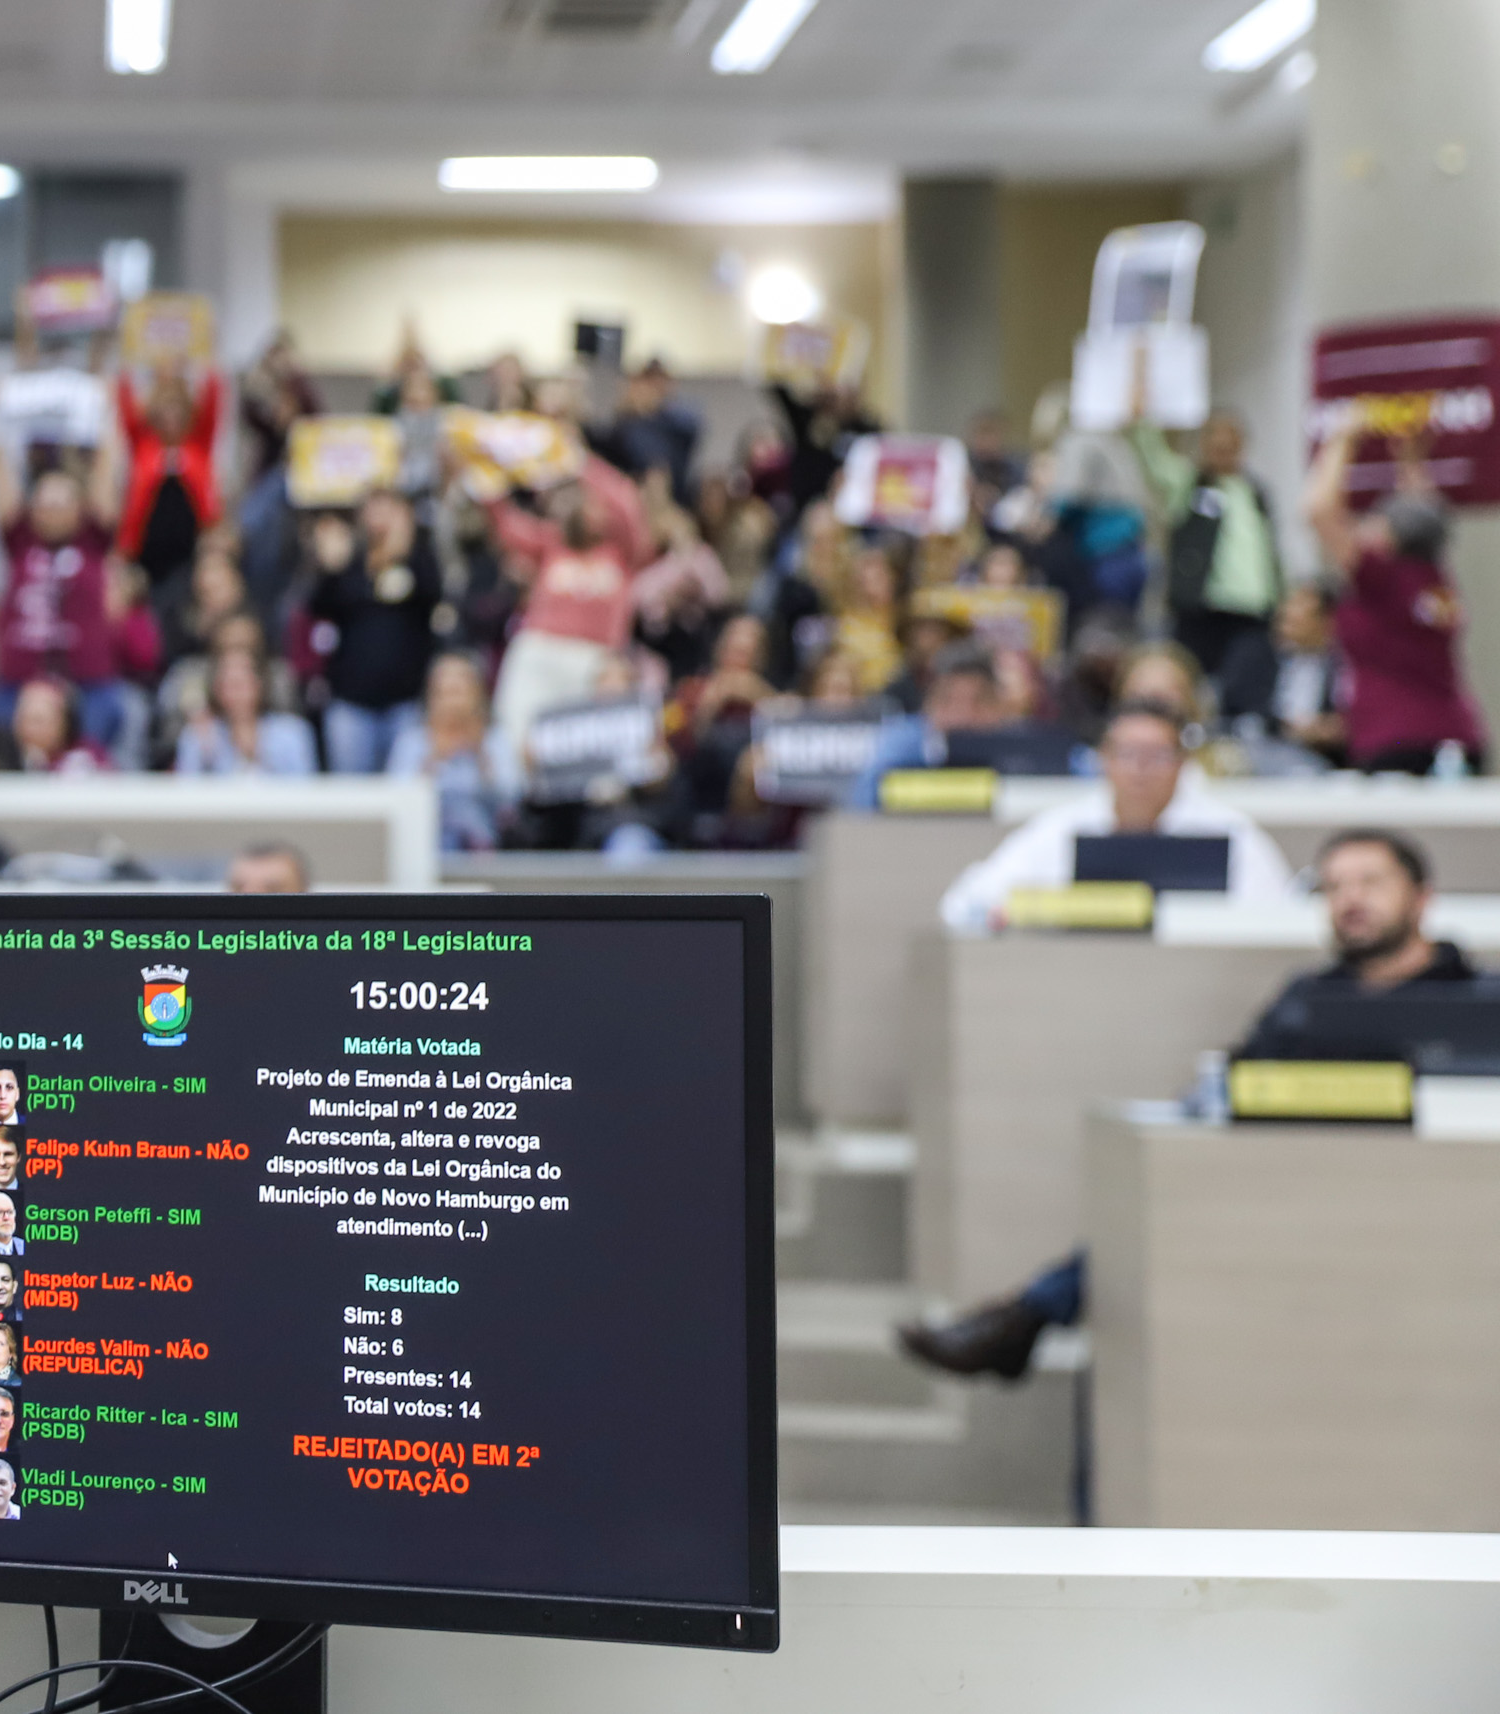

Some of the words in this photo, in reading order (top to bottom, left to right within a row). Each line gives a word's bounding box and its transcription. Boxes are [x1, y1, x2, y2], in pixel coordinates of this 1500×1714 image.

[50, 930, 76, 949] da
[110, 930, 190, 949] Sessão
[198, 930, 318, 954] Legislativa
[326, 930, 352, 950] da
[404, 931, 532, 955] Legislatura
[350, 981, 489, 1010] 15:00:24
[18, 1033, 46, 1050] Dia
[63, 1034, 83, 1050] 14
[344, 1037, 412, 1055] Matéria
[417, 1038, 481, 1056] Votada
[28, 1075, 83, 1091] Darlan
[89, 1076, 156, 1092] Oliveira
[173, 1077, 206, 1093] SIM
[257, 1068, 322, 1089] Projeto
[327, 1069, 350, 1086] de
[355, 1070, 430, 1088] Emenda
[435, 1070, 447, 1088] à
[452, 1071, 480, 1089] Lei
[486, 1071, 572, 1093] Orgânica
[27, 1094, 75, 1113] (PDT)
[310, 1099, 398, 1120] Municipal
[428, 1101, 437, 1118] 1
[444, 1101, 467, 1119] de
[472, 1102, 516, 1120] 2022
[26, 1139, 80, 1158] Felipe
[84, 1140, 132, 1157] Kuhn
[137, 1141, 190, 1158] Braun
[207, 1140, 249, 1160] NÃO
[286, 1127, 395, 1150] Acrescenta,
[401, 1130, 453, 1148] altera
[458, 1135, 470, 1148] e
[475, 1135, 540, 1153] revoga
[26, 1158, 63, 1178] (PP)
[266, 1156, 379, 1177] dispositivos
[384, 1159, 406, 1176] da
[412, 1159, 440, 1177] Lei
[445, 1159, 531, 1181] Orgânica
[537, 1162, 561, 1179] do
[259, 1185, 348, 1207] Município
[353, 1188, 376, 1205] de
[382, 1189, 430, 1207] Novo
[436, 1190, 535, 1213] Hamburgo
[540, 1196, 569, 1210] em
[25, 1204, 89, 1221] Gerson
[95, 1206, 150, 1223] Peteffi
[168, 1209, 200, 1225] SIM
[25, 1224, 78, 1244] (MDB)
[337, 1217, 453, 1237] atendimento
[458, 1220, 488, 1241] (...)
[24, 1270, 98, 1290] Inspetor
[102, 1273, 134, 1290] Luz
[151, 1271, 192, 1292] NÃO
[365, 1274, 459, 1294] Resultado
[24, 1290, 79, 1310] (MDB)
[344, 1307, 385, 1325] Sim:
[391, 1308, 402, 1325] 8
[23, 1336, 96, 1355] Lourdes
[100, 1339, 150, 1357] Valim
[167, 1339, 209, 1359] NÃO
[344, 1336, 386, 1355] Não:
[392, 1339, 403, 1356] 6
[23, 1356, 143, 1379] (REPUBLICA)
[344, 1366, 443, 1387] Presentes:
[449, 1371, 472, 1388] 14
[23, 1402, 90, 1421] Ricardo
[97, 1406, 145, 1423] Ritter
[162, 1409, 187, 1425] Ica
[205, 1411, 238, 1428] SIM
[344, 1396, 388, 1415] Total
[393, 1399, 452, 1417] votos:
[459, 1401, 481, 1419] 14
[22, 1422, 85, 1443] (PSDB)
[293, 1435, 465, 1468] REJEITADO(A)
[473, 1444, 509, 1466] EM
[21, 1468, 65, 1485] Vladi
[71, 1471, 155, 1493] Lourenço
[173, 1476, 205, 1493] SIM
[348, 1468, 469, 1496] VOTAÇÃO
[21, 1488, 84, 1509] (PSDB)
[124, 1580, 189, 1604] DELL
